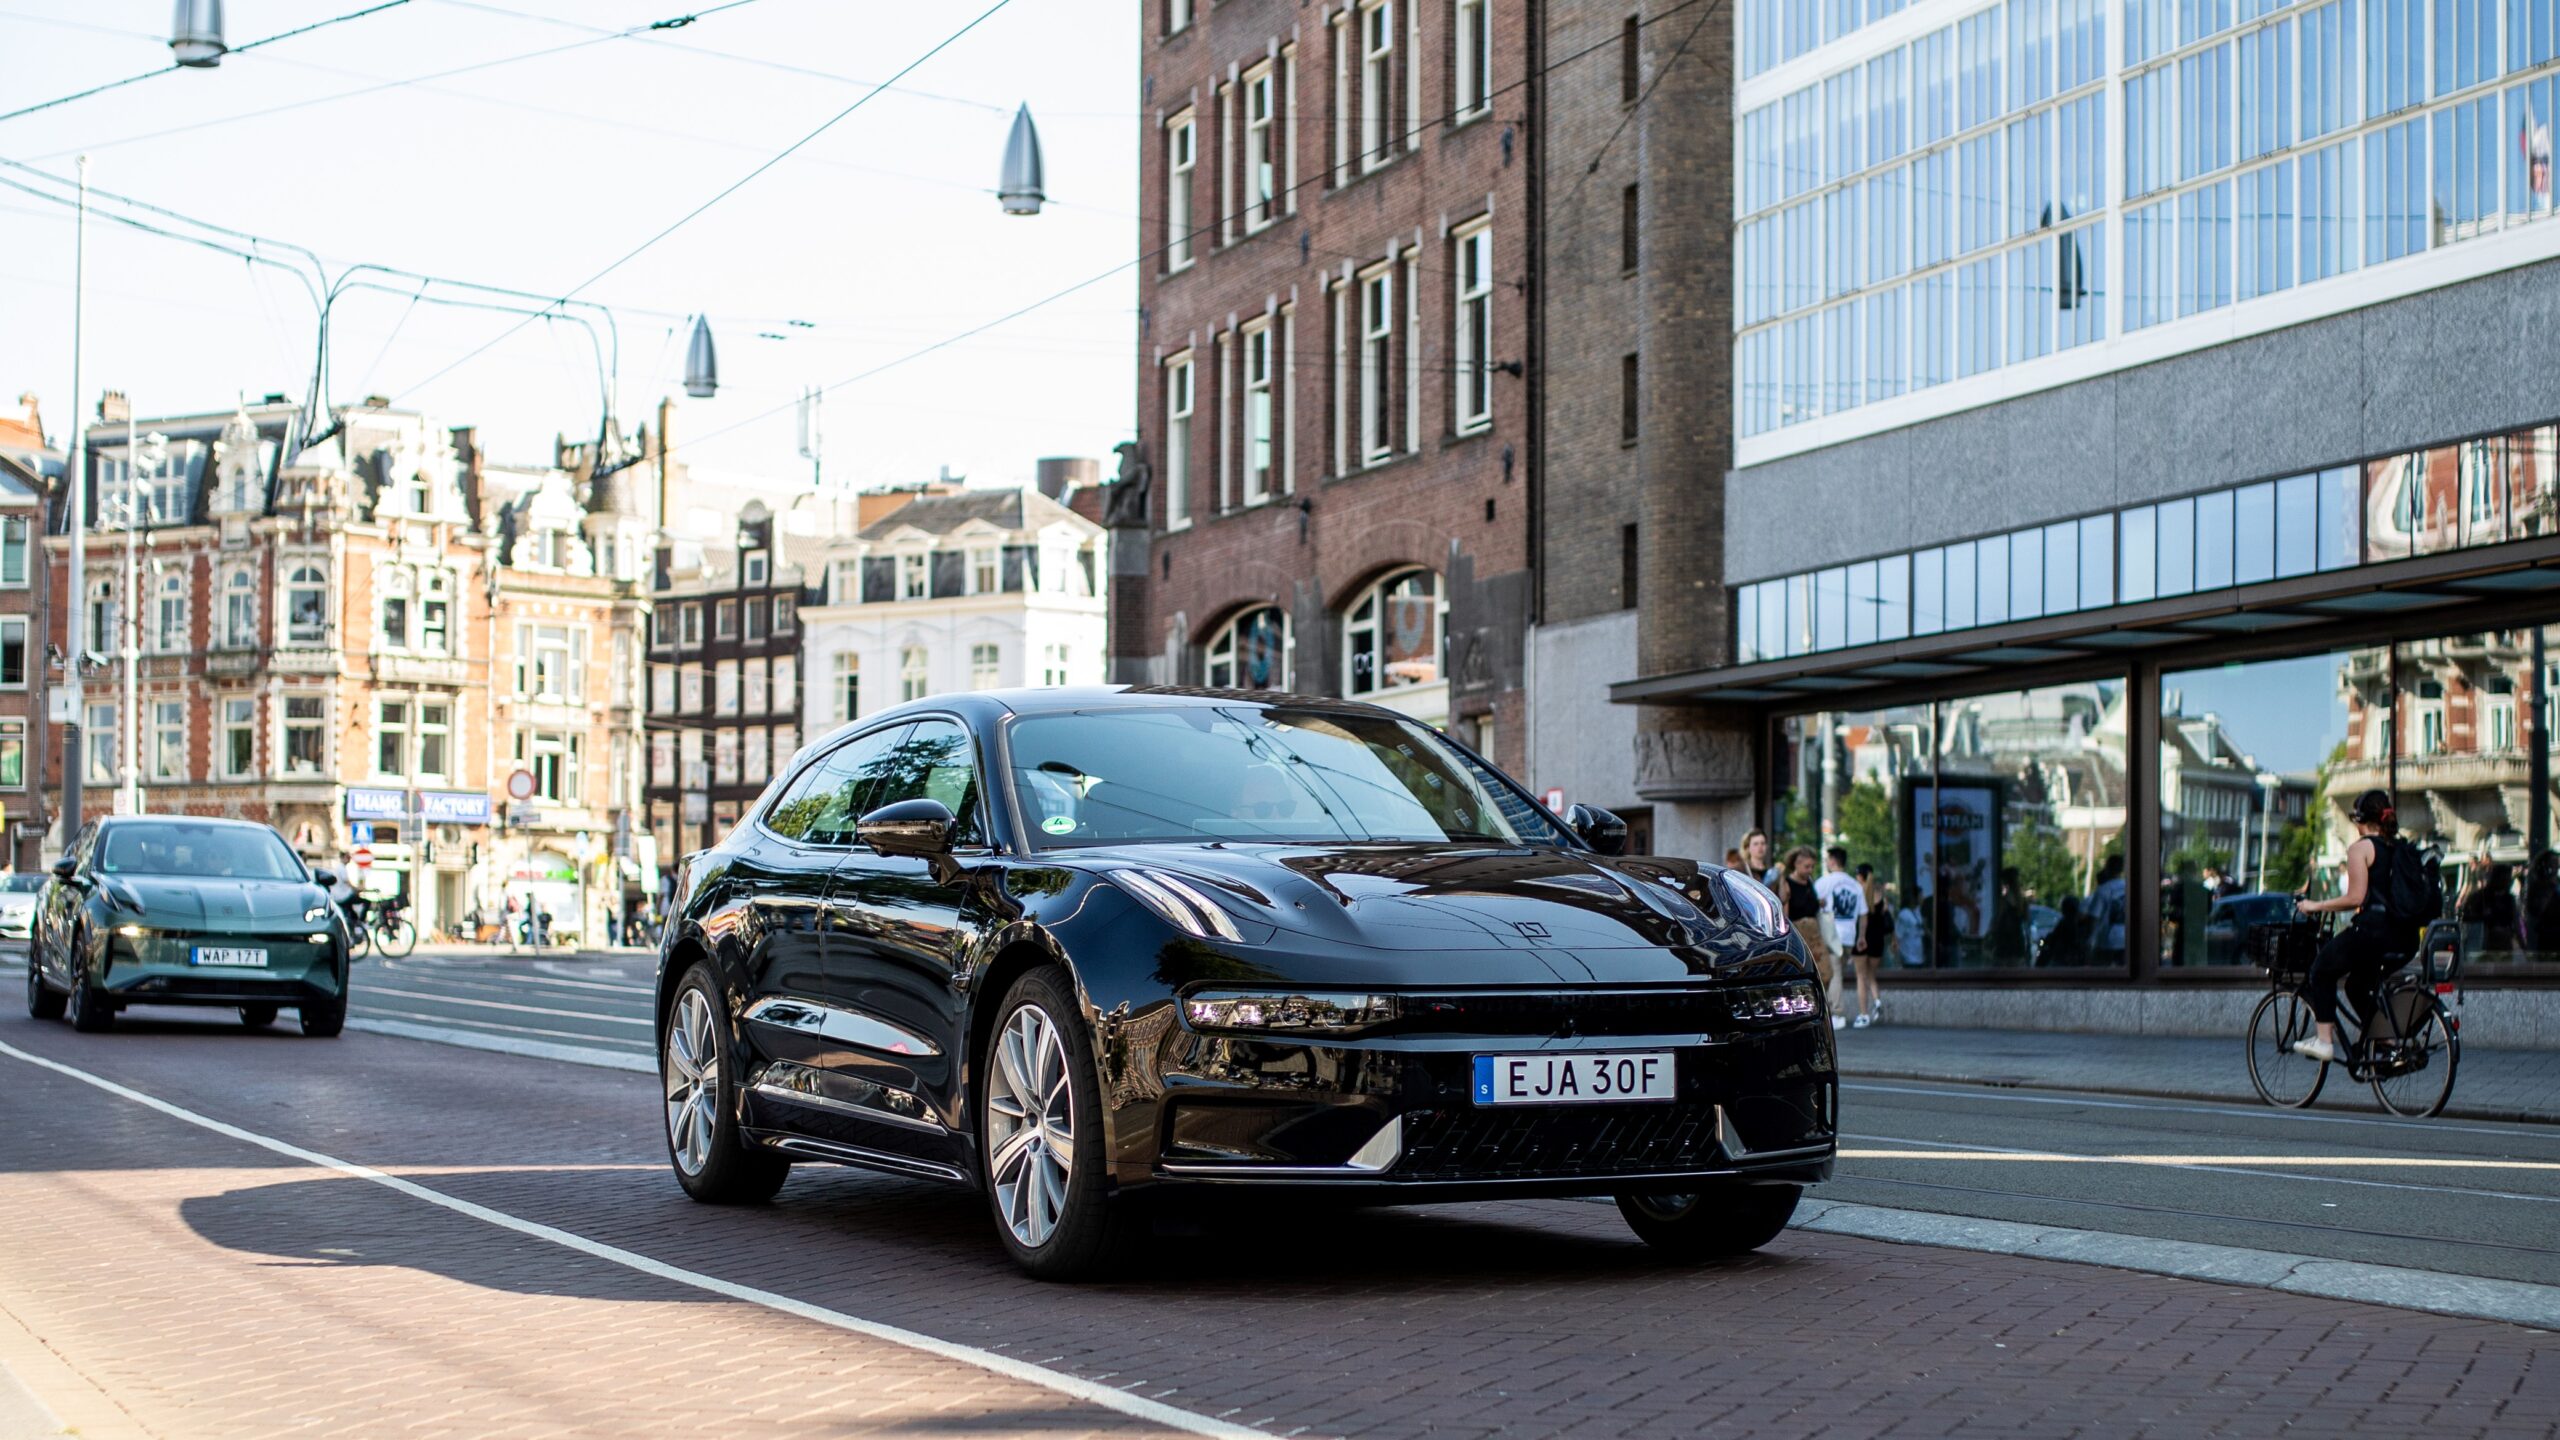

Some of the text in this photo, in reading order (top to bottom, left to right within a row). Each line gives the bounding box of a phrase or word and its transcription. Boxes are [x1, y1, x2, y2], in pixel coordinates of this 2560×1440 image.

[424, 796, 484, 815] FACTORY
[203, 948, 260, 964] WAP 17T
[1481, 1058, 1659, 1096] S EJA 30F
